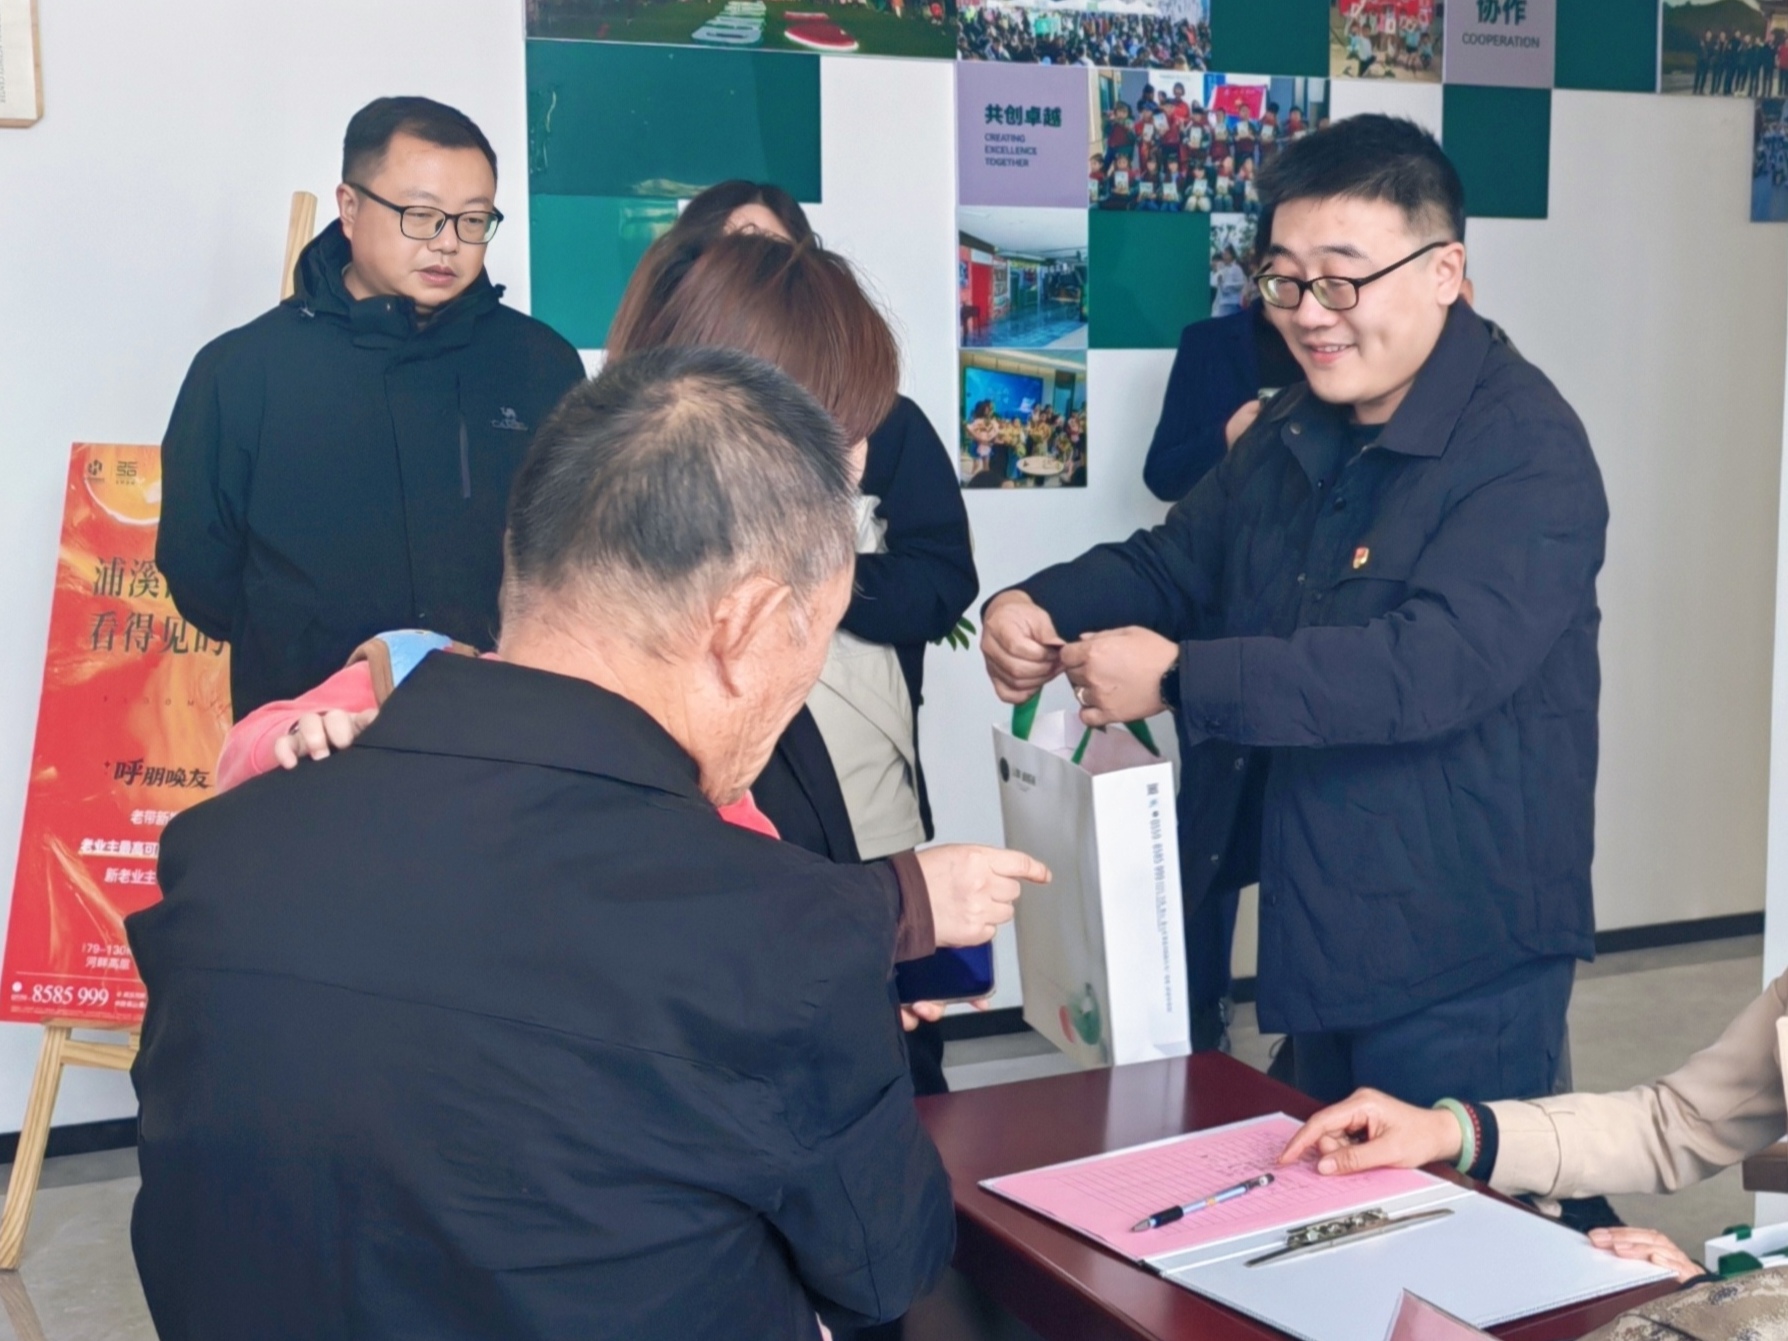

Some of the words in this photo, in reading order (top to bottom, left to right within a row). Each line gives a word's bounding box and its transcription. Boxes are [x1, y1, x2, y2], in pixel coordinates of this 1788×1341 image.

[1476, 0, 1527, 26] 协作
[1461, 32, 1540, 48] COOPERATION
[984, 104, 1062, 128] 共创卓越
[984, 133, 1026, 143] CREATING
[984, 145, 1037, 156] EXCELLENCE
[984, 157, 1029, 168] TOGETHER
[93, 556, 173, 598] 浦溪
[113, 758, 212, 790] 呼朋唤友
[130, 809, 179, 826] 老带新
[31, 983, 74, 1005] 8585
[77, 987, 110, 1007] 999
